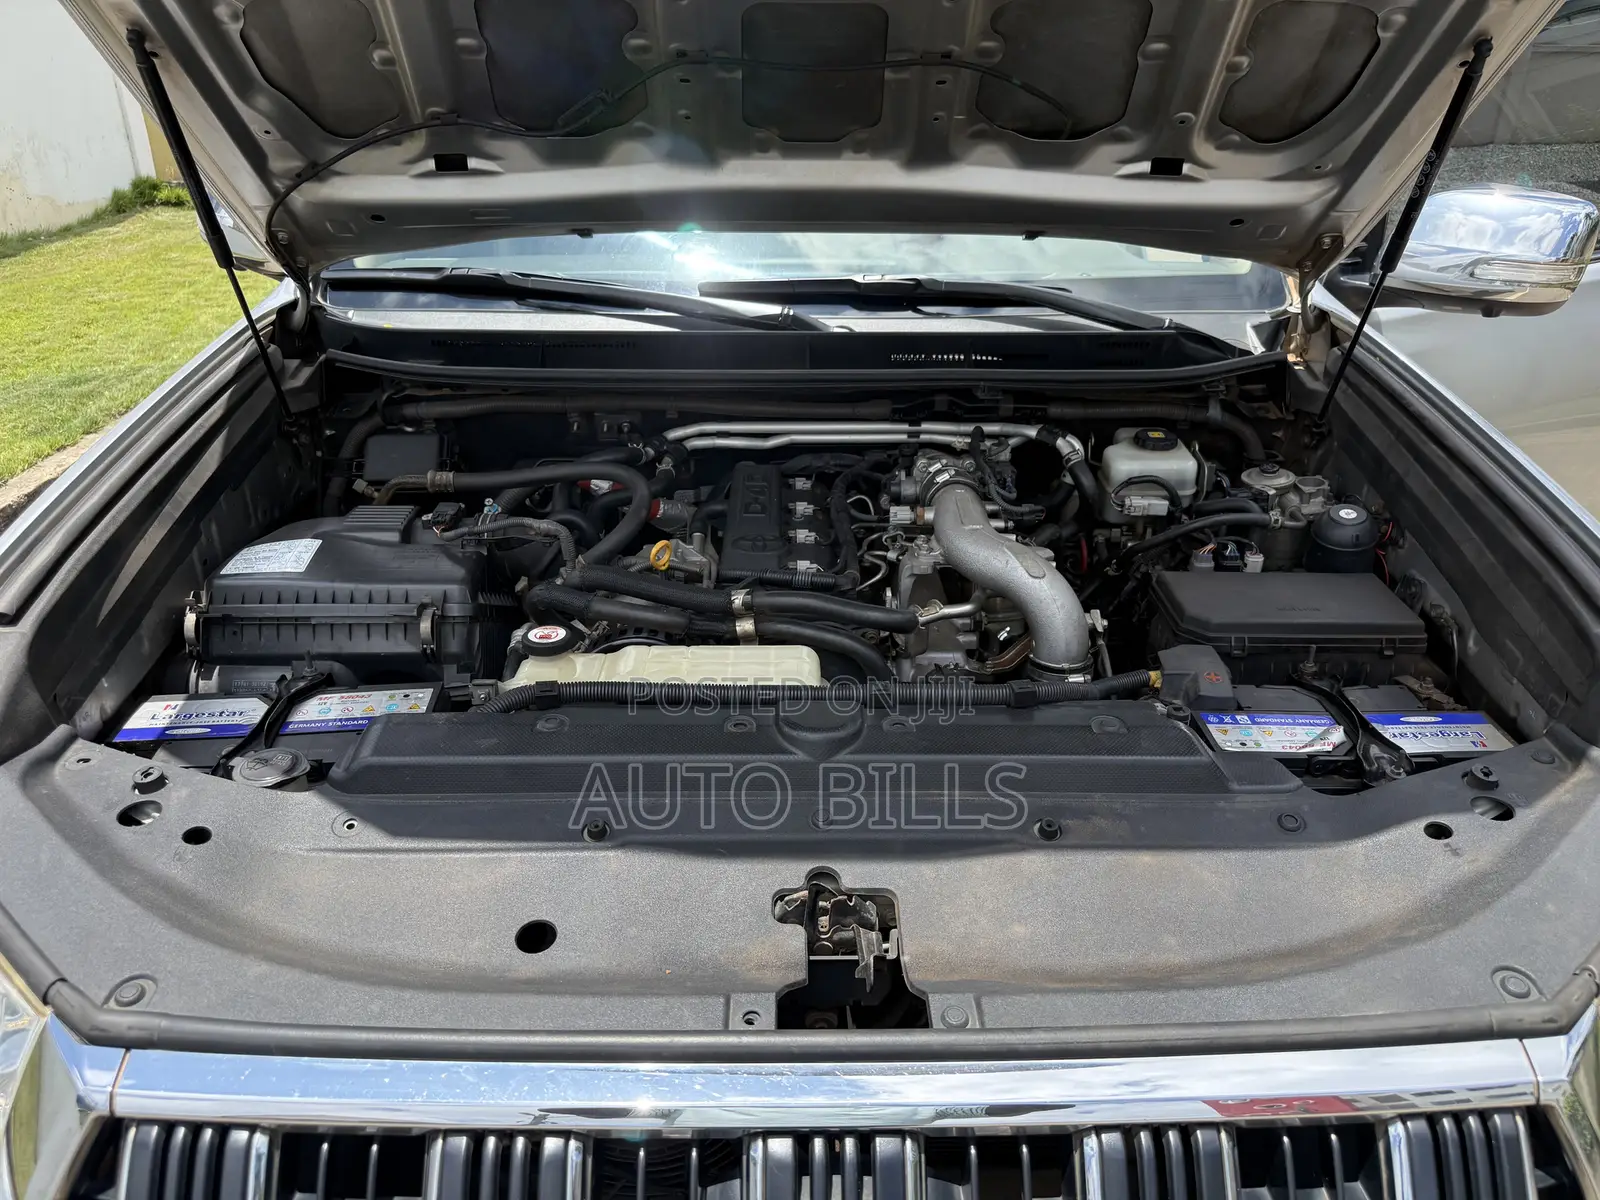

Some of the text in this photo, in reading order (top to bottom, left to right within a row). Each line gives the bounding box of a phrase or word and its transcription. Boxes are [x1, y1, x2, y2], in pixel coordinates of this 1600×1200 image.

[151, 708, 246, 721] Largestar
[328, 719, 369, 727] STANDARD
[1390, 729, 1487, 741] Largestar
